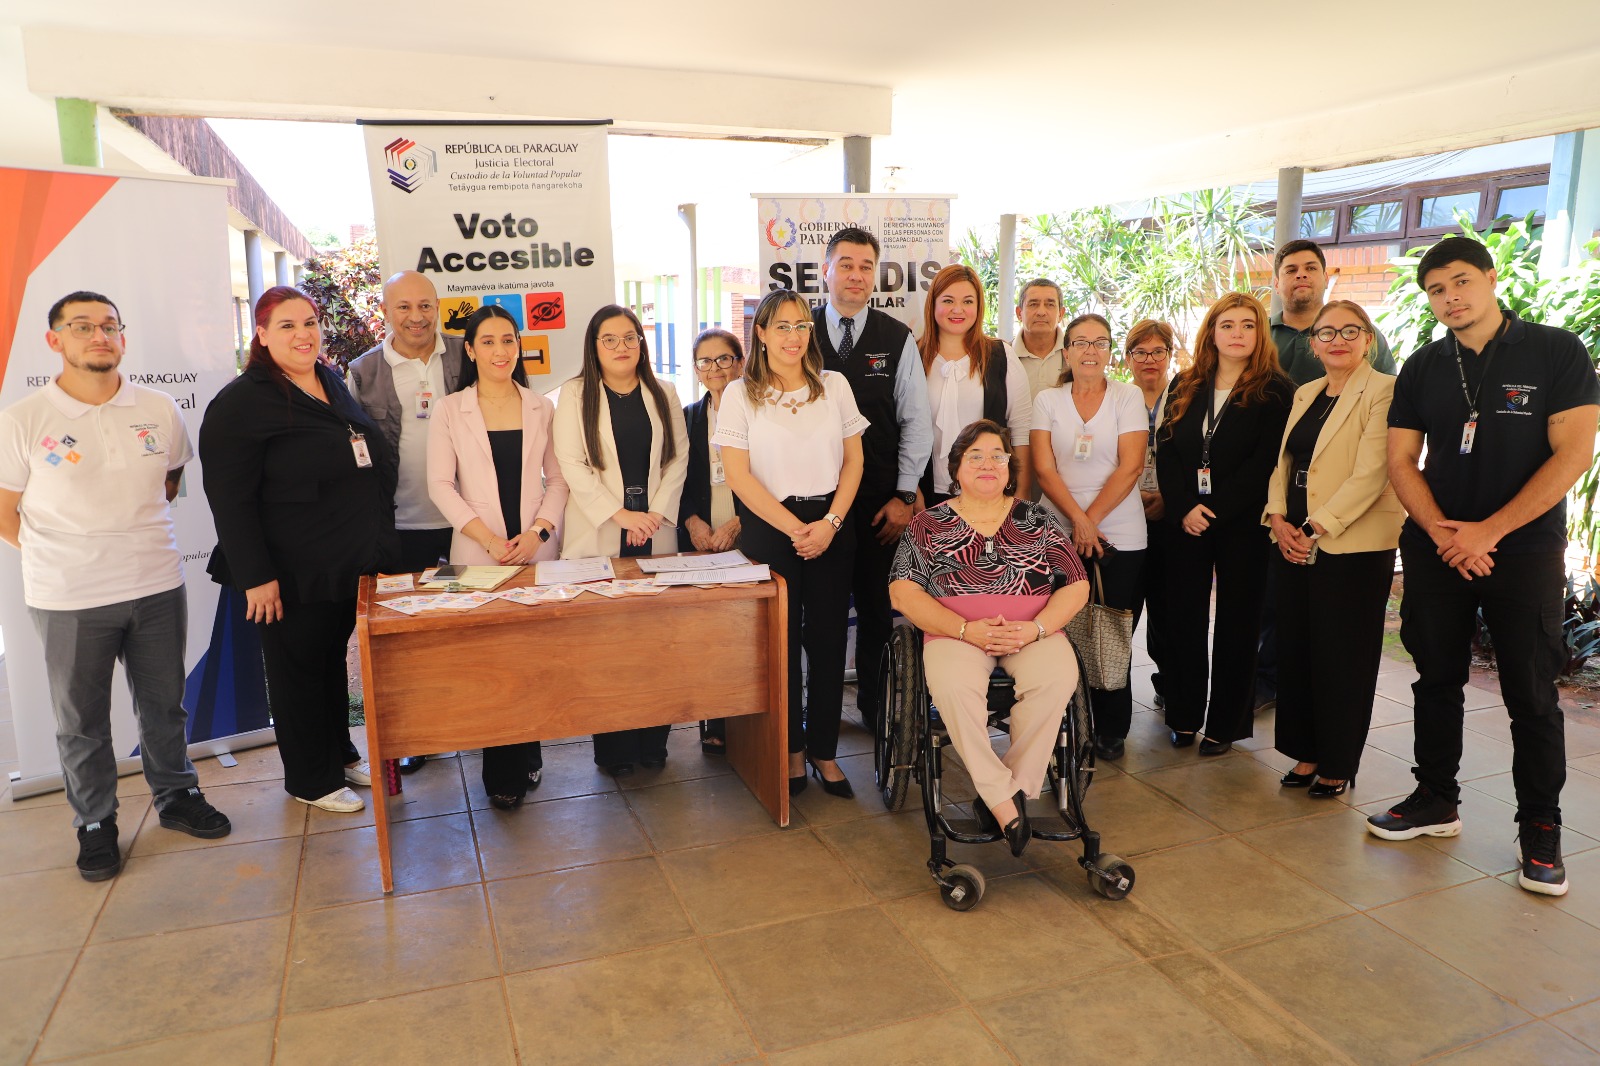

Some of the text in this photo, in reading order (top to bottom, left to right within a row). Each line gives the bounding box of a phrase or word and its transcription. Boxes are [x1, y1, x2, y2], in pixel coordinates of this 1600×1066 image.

[445, 142, 578, 154] REPÚBLICA DEL PARAGUAY
[475, 157, 554, 169] Justicia Electoral
[450, 169, 582, 180] Custodio de la Voluntad Popular
[488, 182, 529, 192] rembipota
[454, 212, 538, 239] Voto
[799, 222, 858, 232] GOBIERNO
[800, 233, 833, 244] PARA
[416, 241, 595, 273] Accesible
[768, 261, 942, 293] SEDIS
[531, 280, 554, 290] javota
[866, 297, 905, 309] ILAR
[129, 373, 198, 383] PARAGUAY
